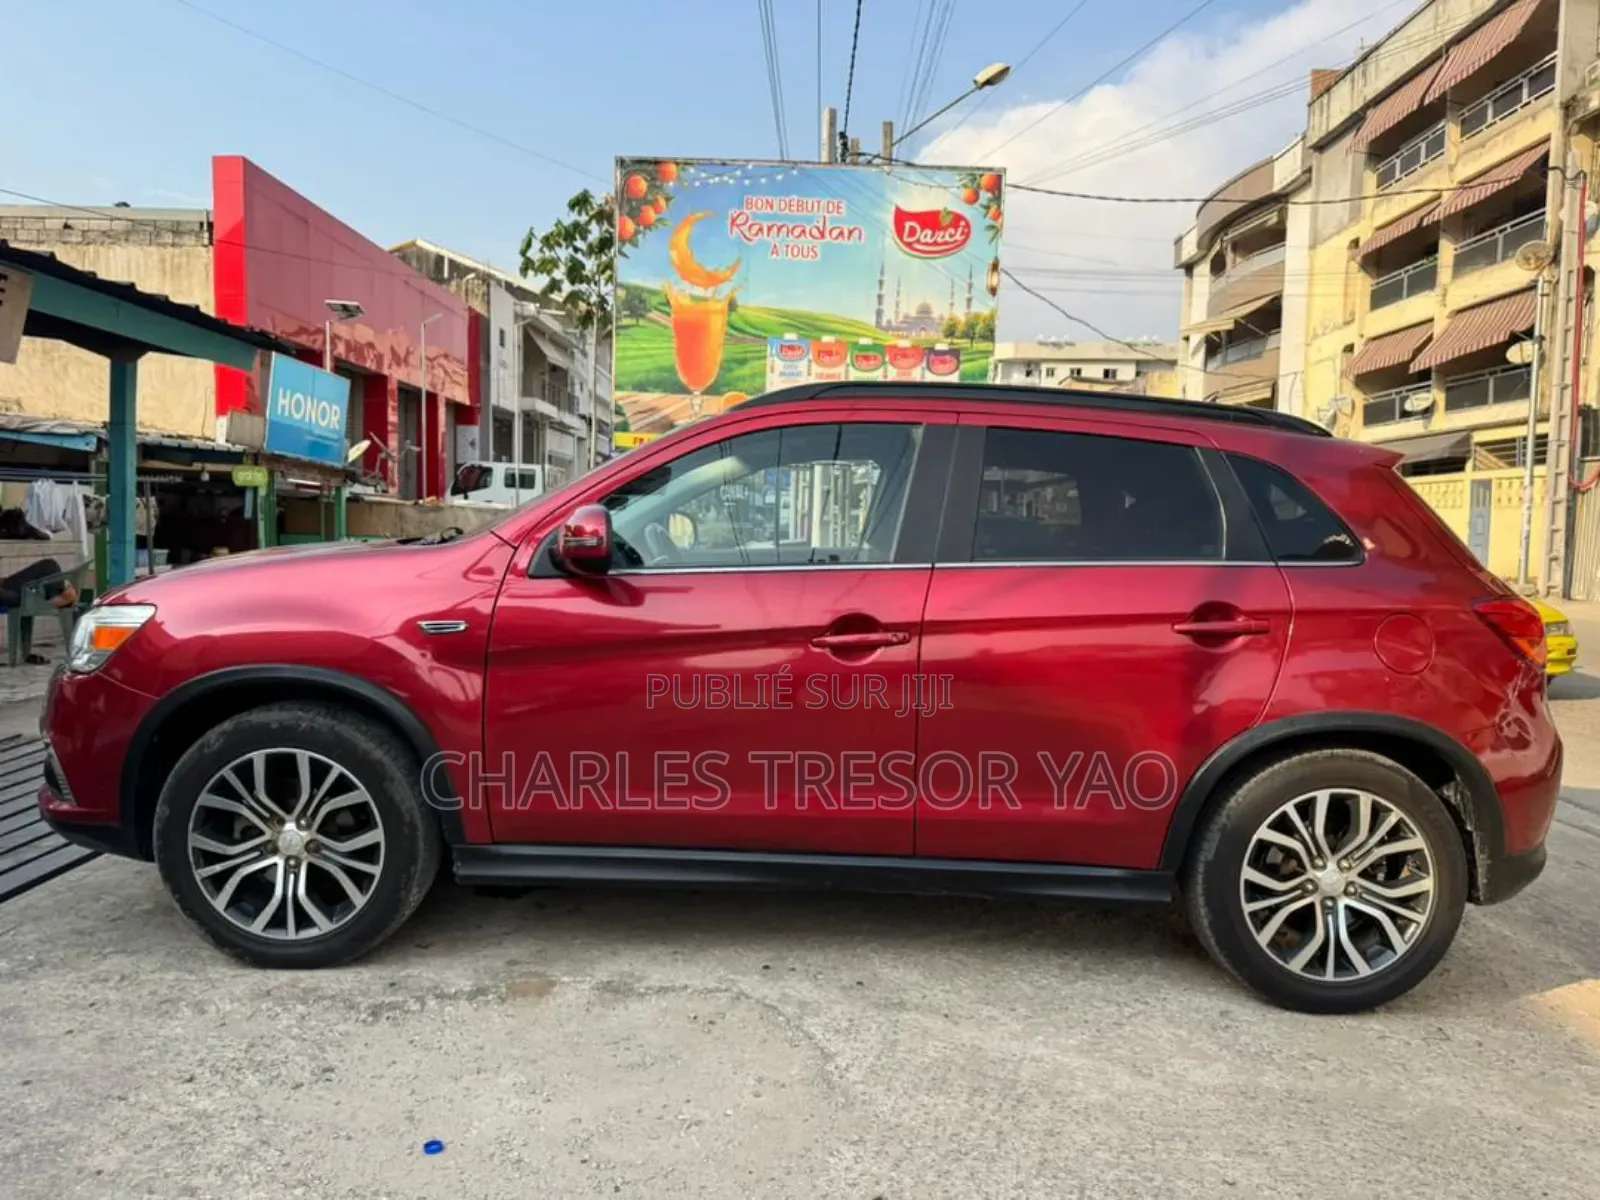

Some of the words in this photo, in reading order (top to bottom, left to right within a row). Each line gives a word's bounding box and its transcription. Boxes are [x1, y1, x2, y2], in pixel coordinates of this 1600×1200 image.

[745, 195, 774, 211] BON
[826, 199, 844, 215] DE
[729, 210, 863, 242] Ramadan
[903, 220, 966, 243] Darci
[784, 243, 818, 260] TOUS
[277, 387, 340, 430] HONOR
